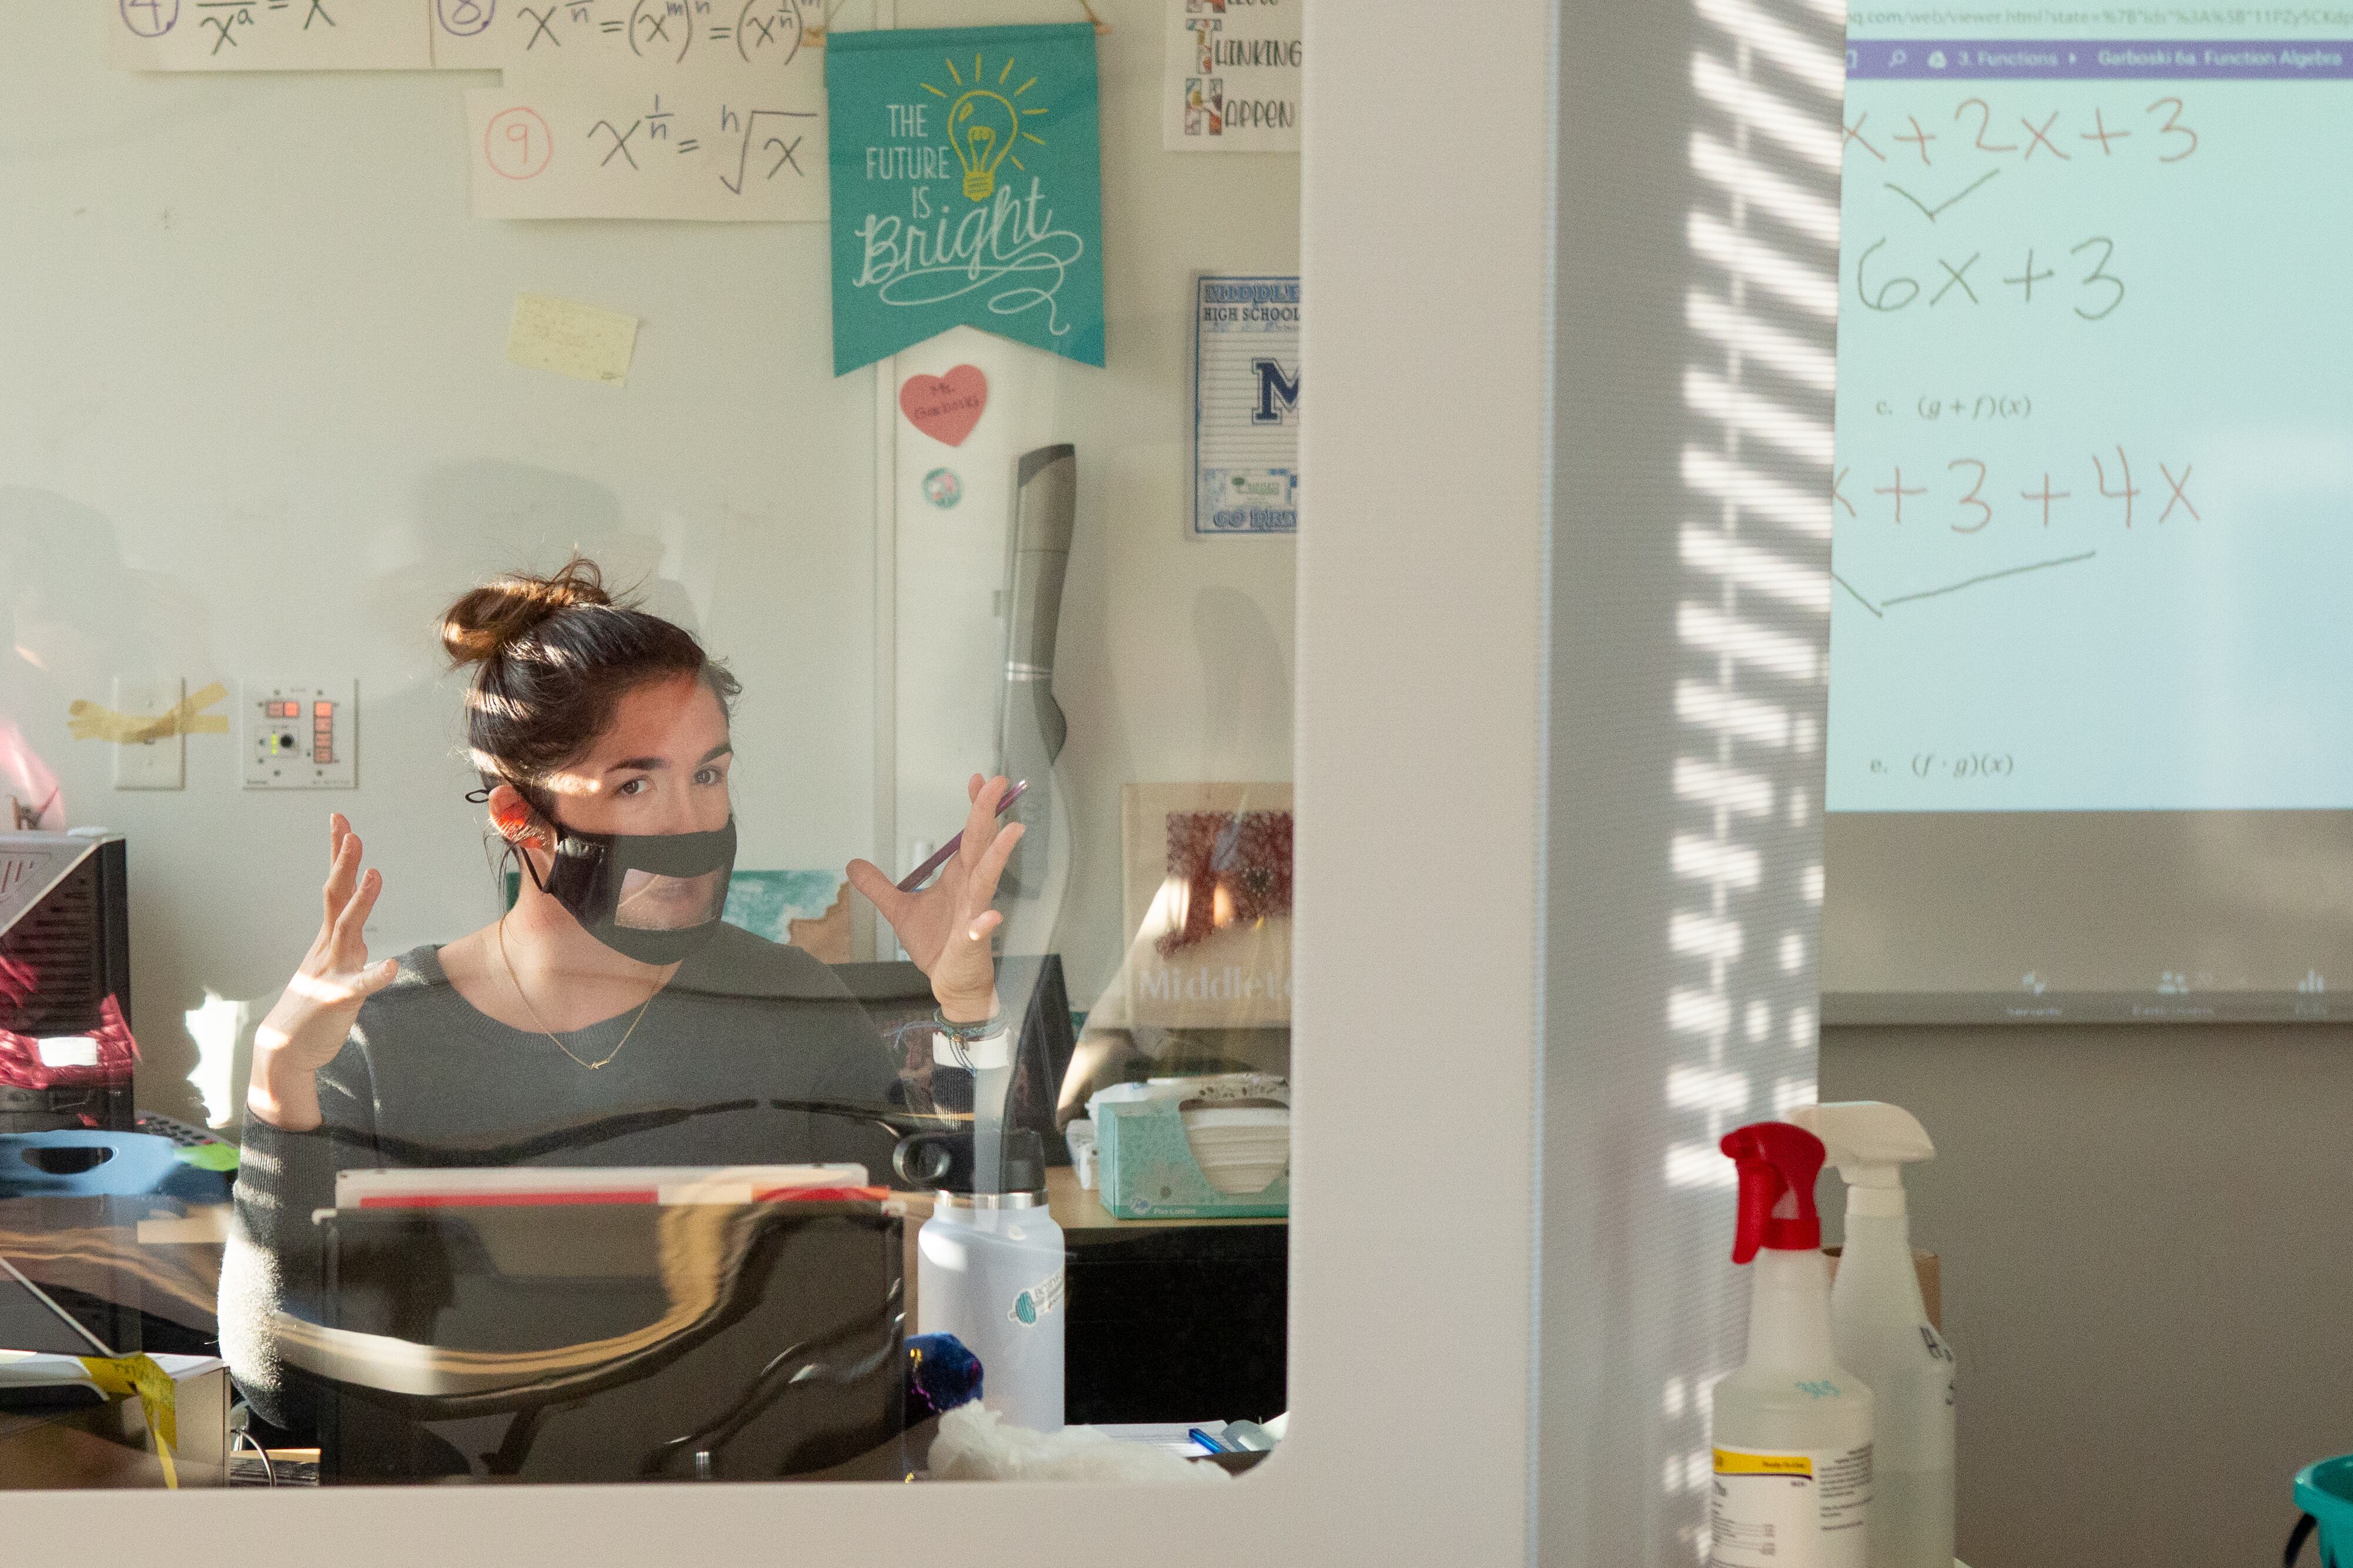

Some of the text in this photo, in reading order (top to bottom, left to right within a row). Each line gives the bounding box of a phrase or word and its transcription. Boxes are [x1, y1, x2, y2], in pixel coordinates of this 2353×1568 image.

[1976, 50, 2059, 67] Functions
[2097, 48, 2174, 66] Garboski
[2203, 49, 2277, 67] Function
[2279, 48, 2344, 69] Algebra
[886, 103, 931, 138] THE
[866, 146, 953, 180] FUTURE
[912, 185, 932, 219] IS
[852, 176, 1059, 289] Bright
[1203, 307, 1239, 322] HIGH
